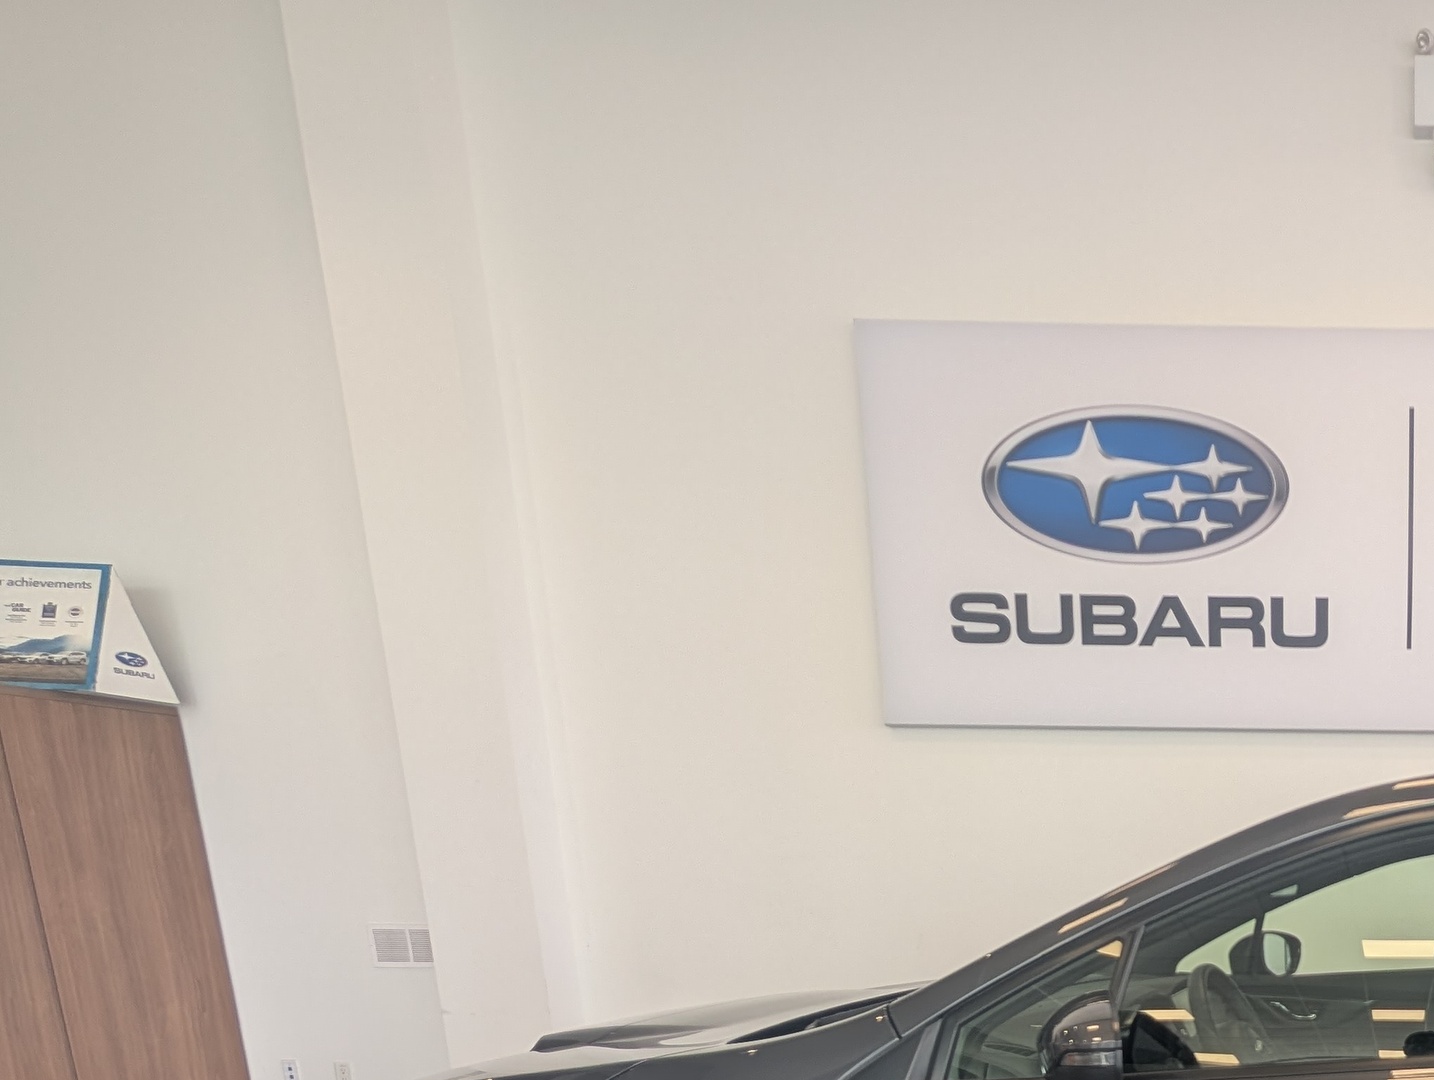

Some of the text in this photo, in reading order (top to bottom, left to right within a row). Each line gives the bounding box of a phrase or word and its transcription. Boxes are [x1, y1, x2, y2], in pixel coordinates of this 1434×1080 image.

[6, 577, 92, 589] achievements
[949, 592, 1329, 649] SUBARU
[113, 667, 155, 679] SUBARU
